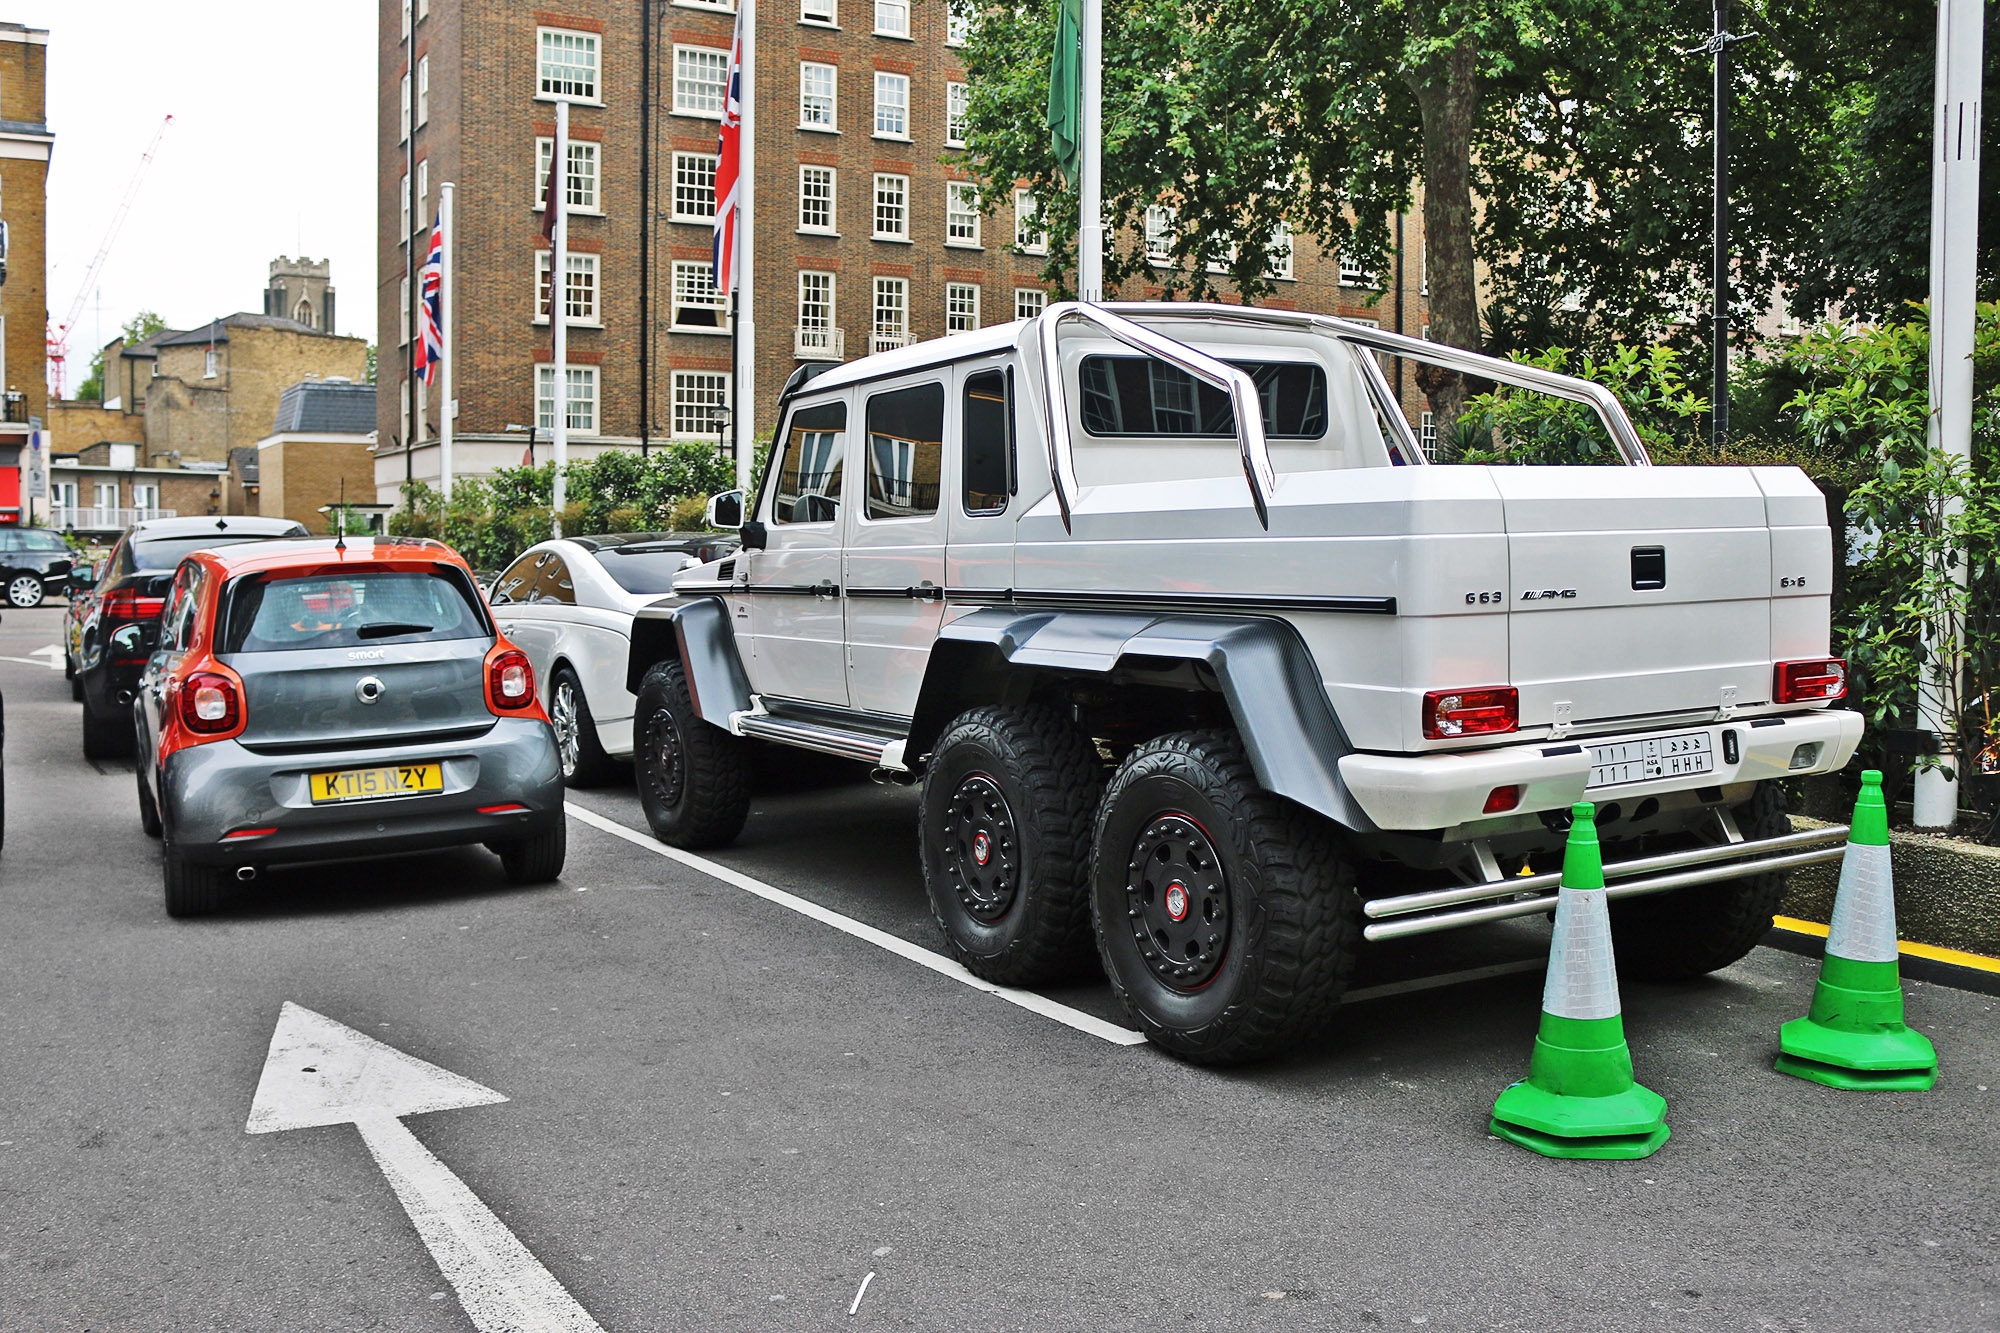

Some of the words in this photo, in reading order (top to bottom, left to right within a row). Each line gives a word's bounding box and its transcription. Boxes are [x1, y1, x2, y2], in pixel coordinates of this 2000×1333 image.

[347, 649, 385, 661] smart
[325, 771, 377, 796] KT15
[383, 767, 427, 791] NZY
